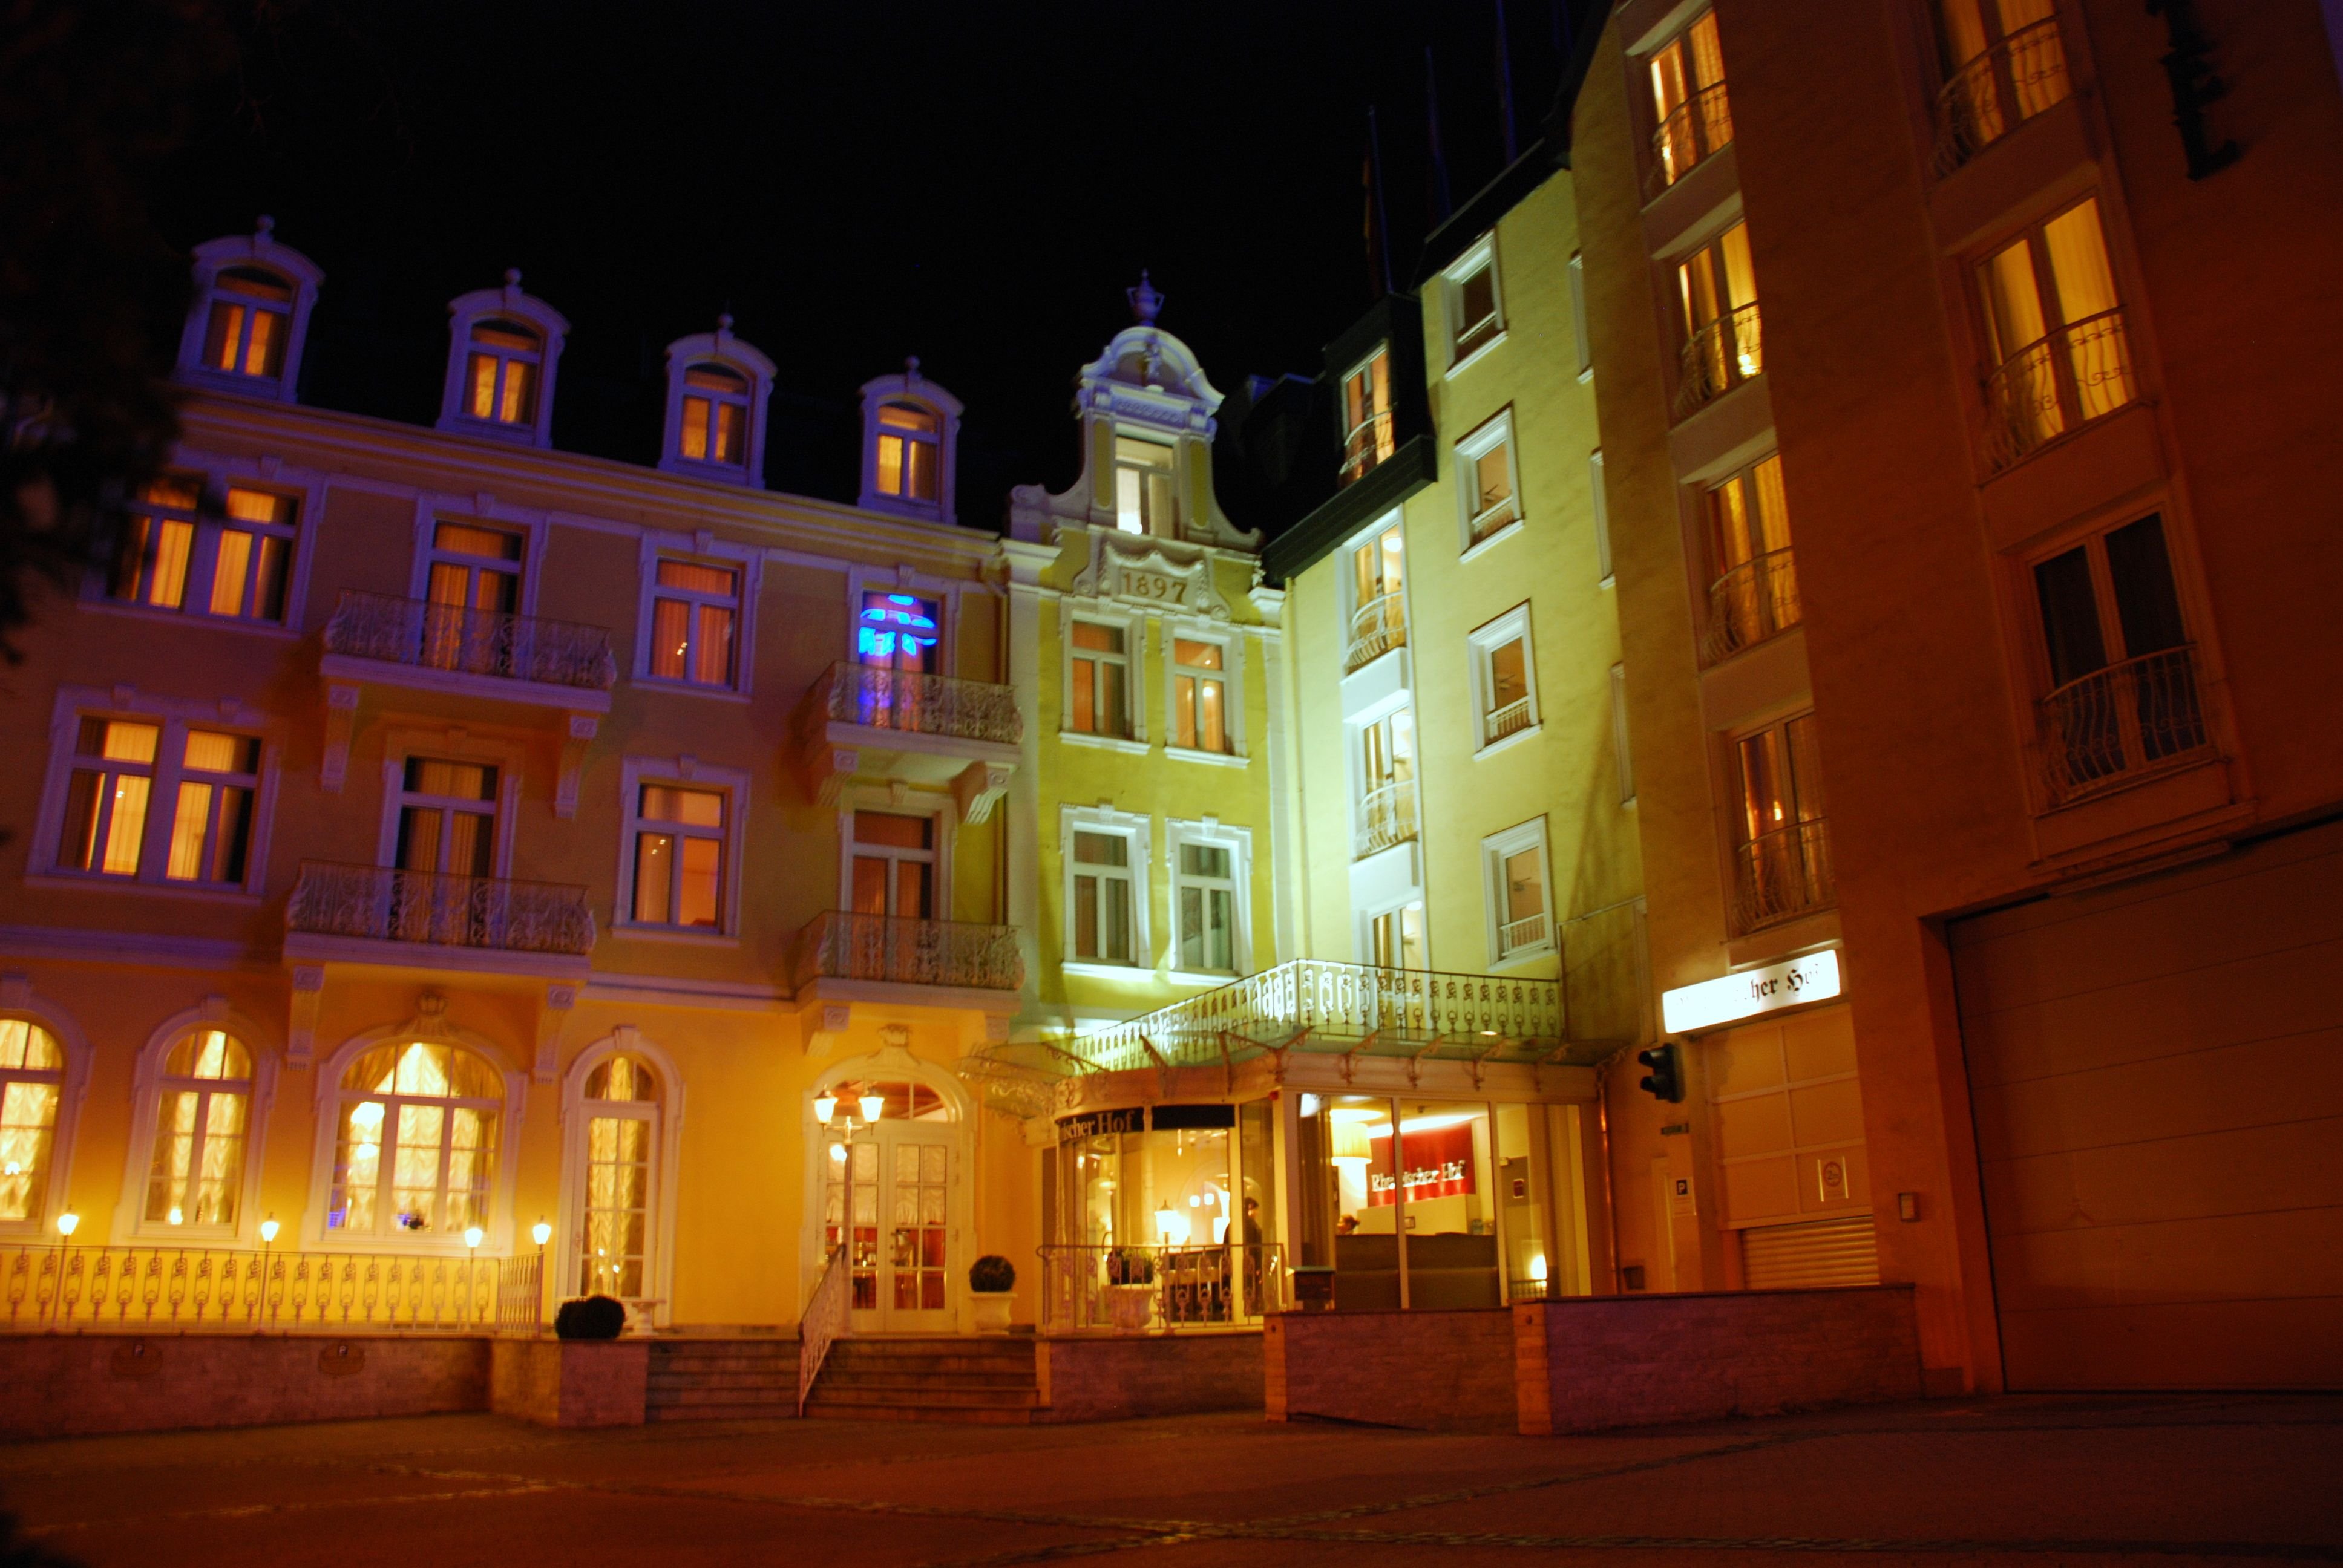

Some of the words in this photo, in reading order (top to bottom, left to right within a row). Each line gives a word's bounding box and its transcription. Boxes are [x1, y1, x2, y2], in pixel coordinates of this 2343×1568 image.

[1122, 572, 1188, 604] 1897
[1097, 1109, 1135, 1134] Hof
[1441, 1159, 1466, 1183] Hof
